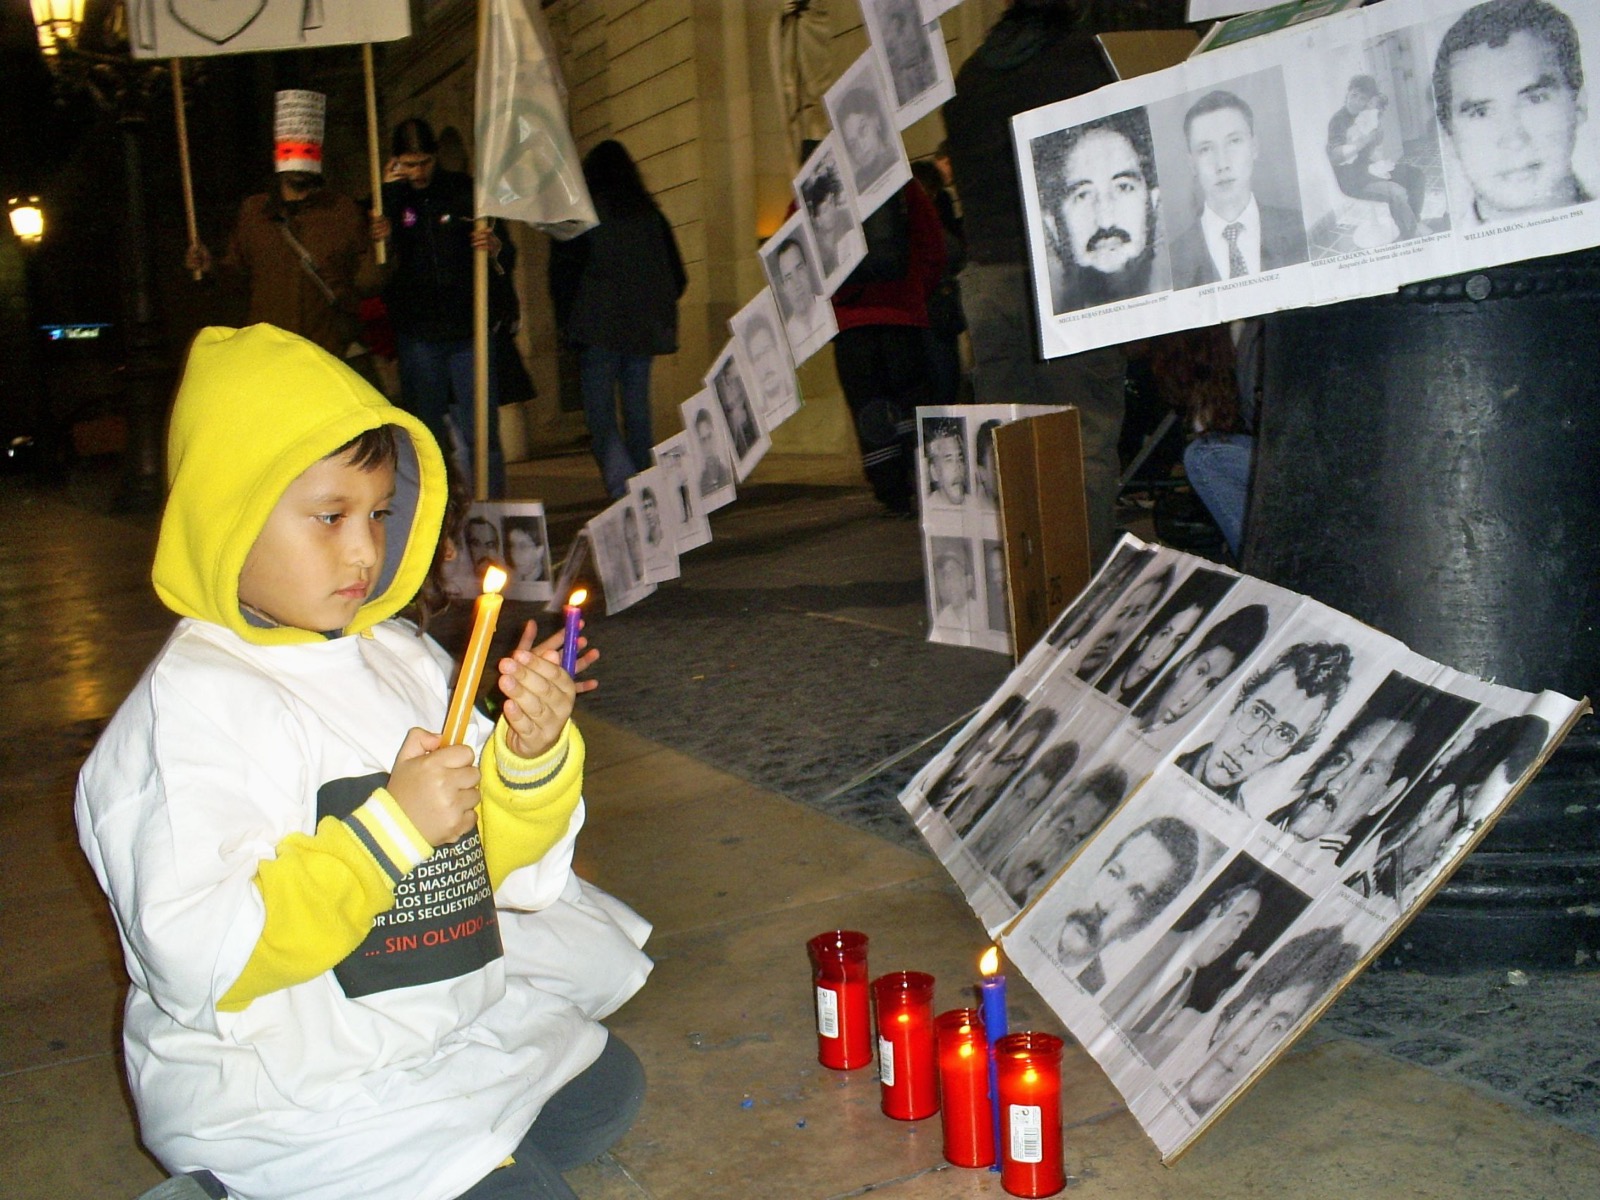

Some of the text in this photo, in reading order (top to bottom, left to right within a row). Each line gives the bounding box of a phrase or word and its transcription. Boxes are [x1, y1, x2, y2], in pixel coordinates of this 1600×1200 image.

[1464, 229, 1496, 241] WILLIAM
[1526, 214, 1559, 228] Asesinado
[1217, 283, 1238, 292] PARDO
[418, 847, 483, 878] DESPLAZADOS
[419, 861, 485, 892] MASACRADOS
[389, 911, 415, 925] LOS
[418, 886, 491, 921] SECUESTRADOS
[395, 875, 486, 909] LOS EJECUTADOS
[386, 935, 417, 953] SIN
[423, 916, 483, 946] OLVIDO
